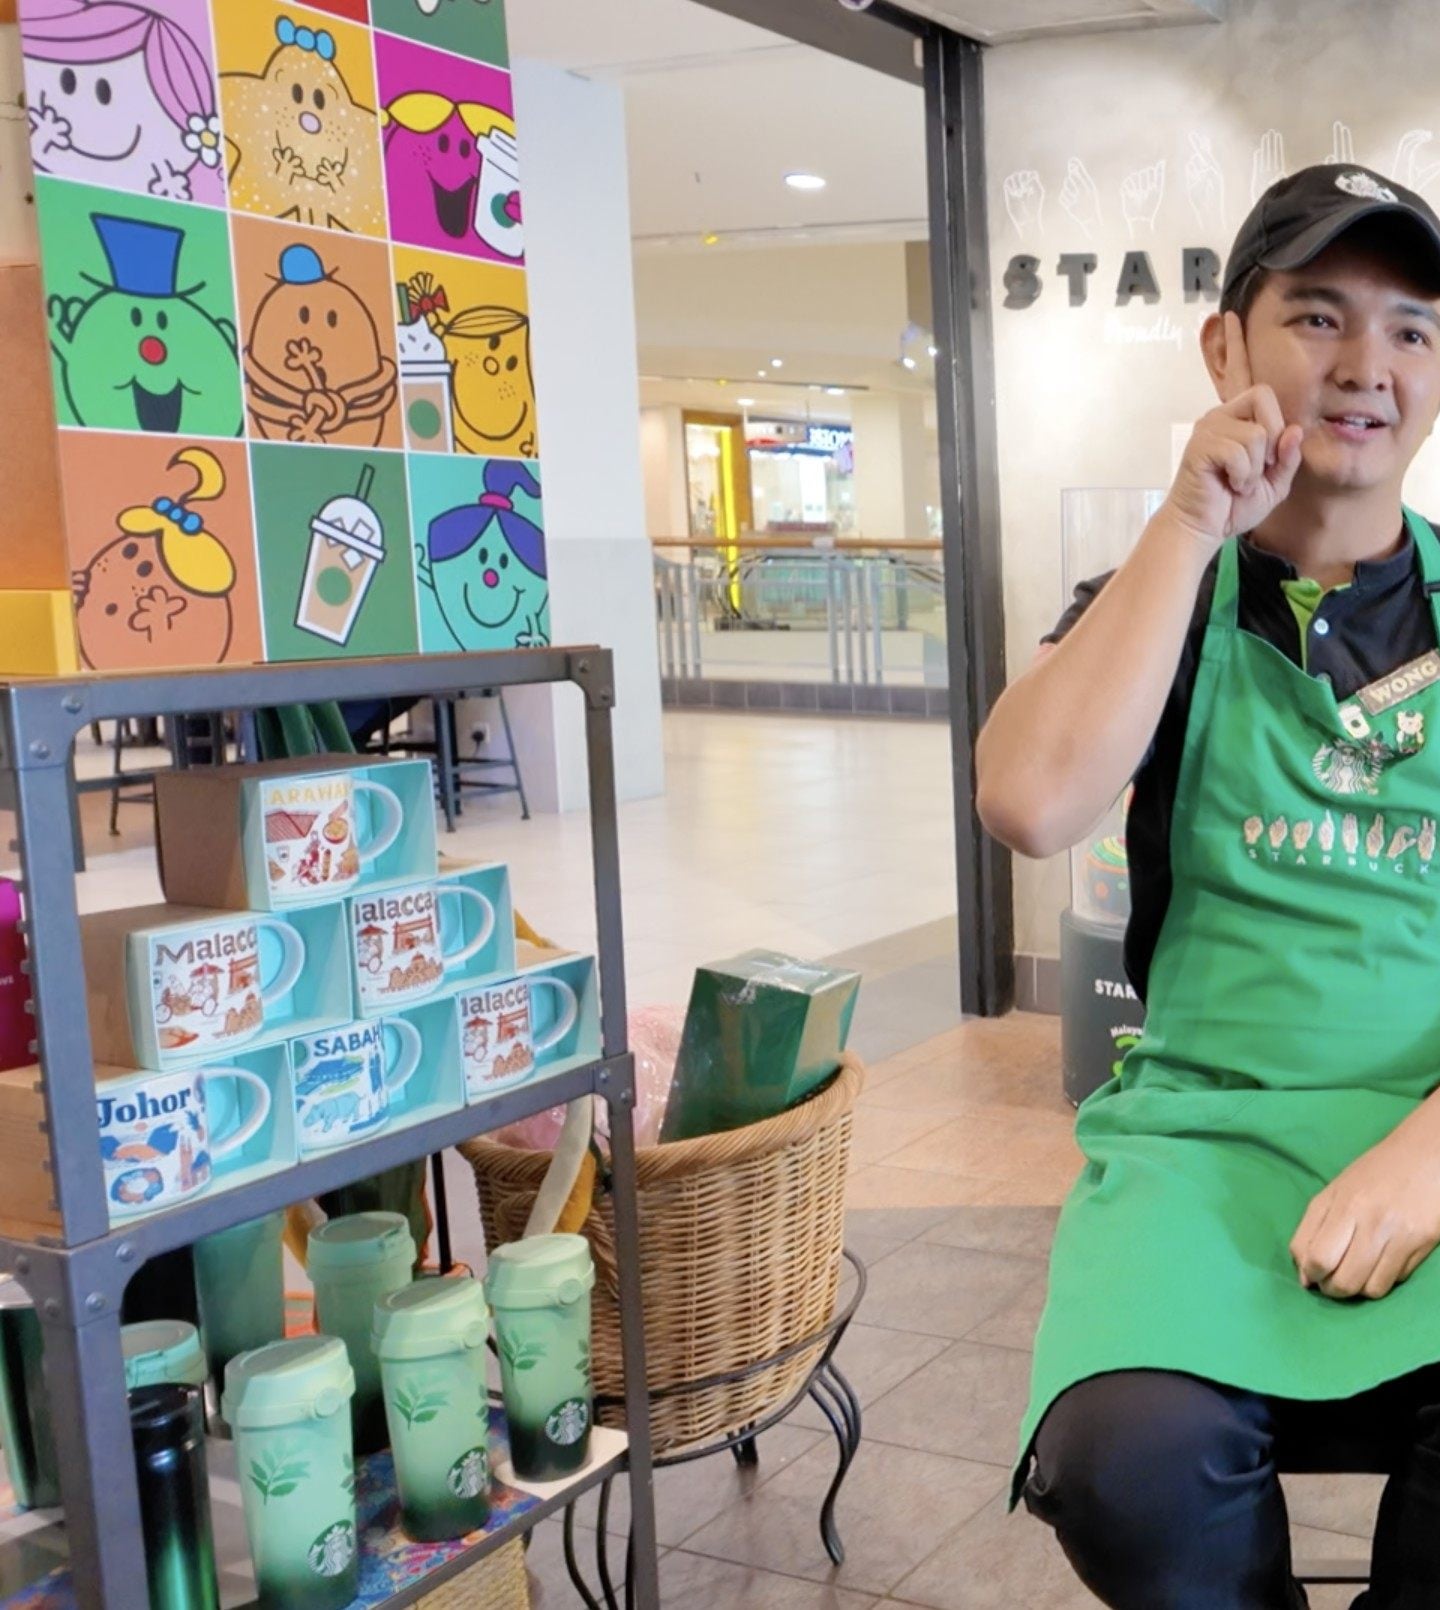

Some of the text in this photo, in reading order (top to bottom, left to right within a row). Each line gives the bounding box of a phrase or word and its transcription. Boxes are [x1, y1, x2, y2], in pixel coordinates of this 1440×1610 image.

[1369, 658, 1438, 705] WONG
[154, 925, 258, 967] Malacc
[313, 1023, 381, 1057] SABAH
[97, 1087, 191, 1129] Johor
